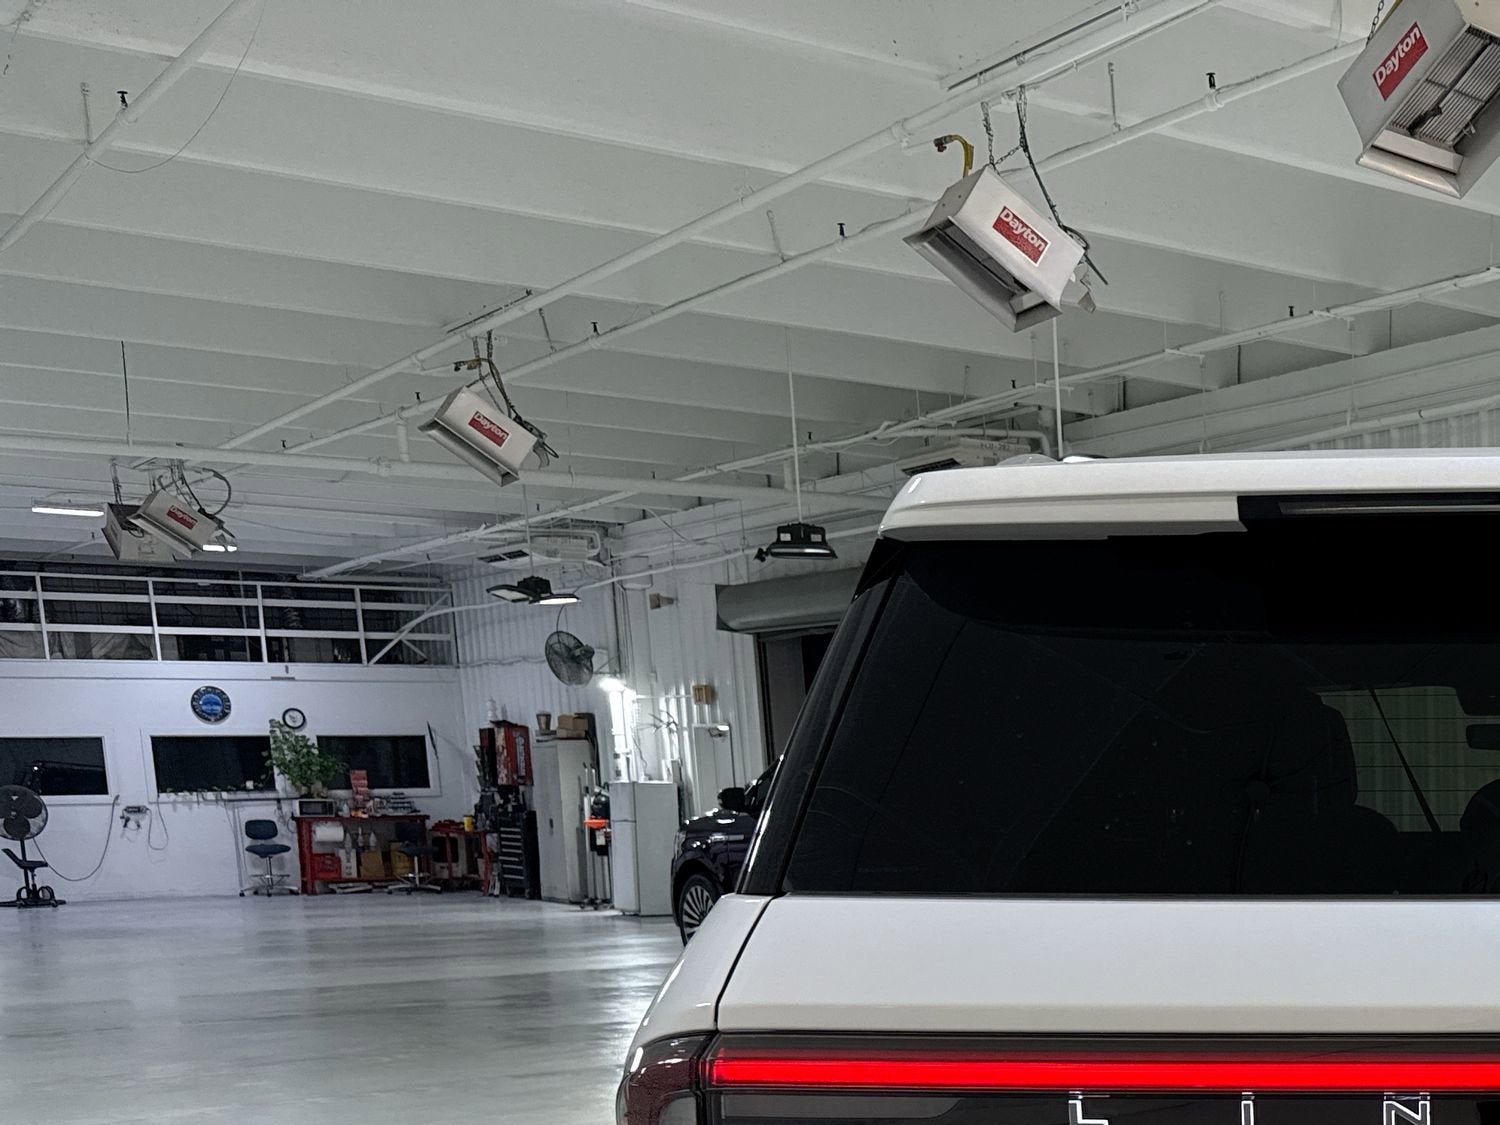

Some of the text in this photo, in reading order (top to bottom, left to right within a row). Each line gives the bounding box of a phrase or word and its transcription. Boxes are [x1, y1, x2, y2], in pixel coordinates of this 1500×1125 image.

[1374, 27, 1420, 86] Dayton
[1000, 208, 1046, 250] Dayton
[474, 412, 508, 440] Dayton
